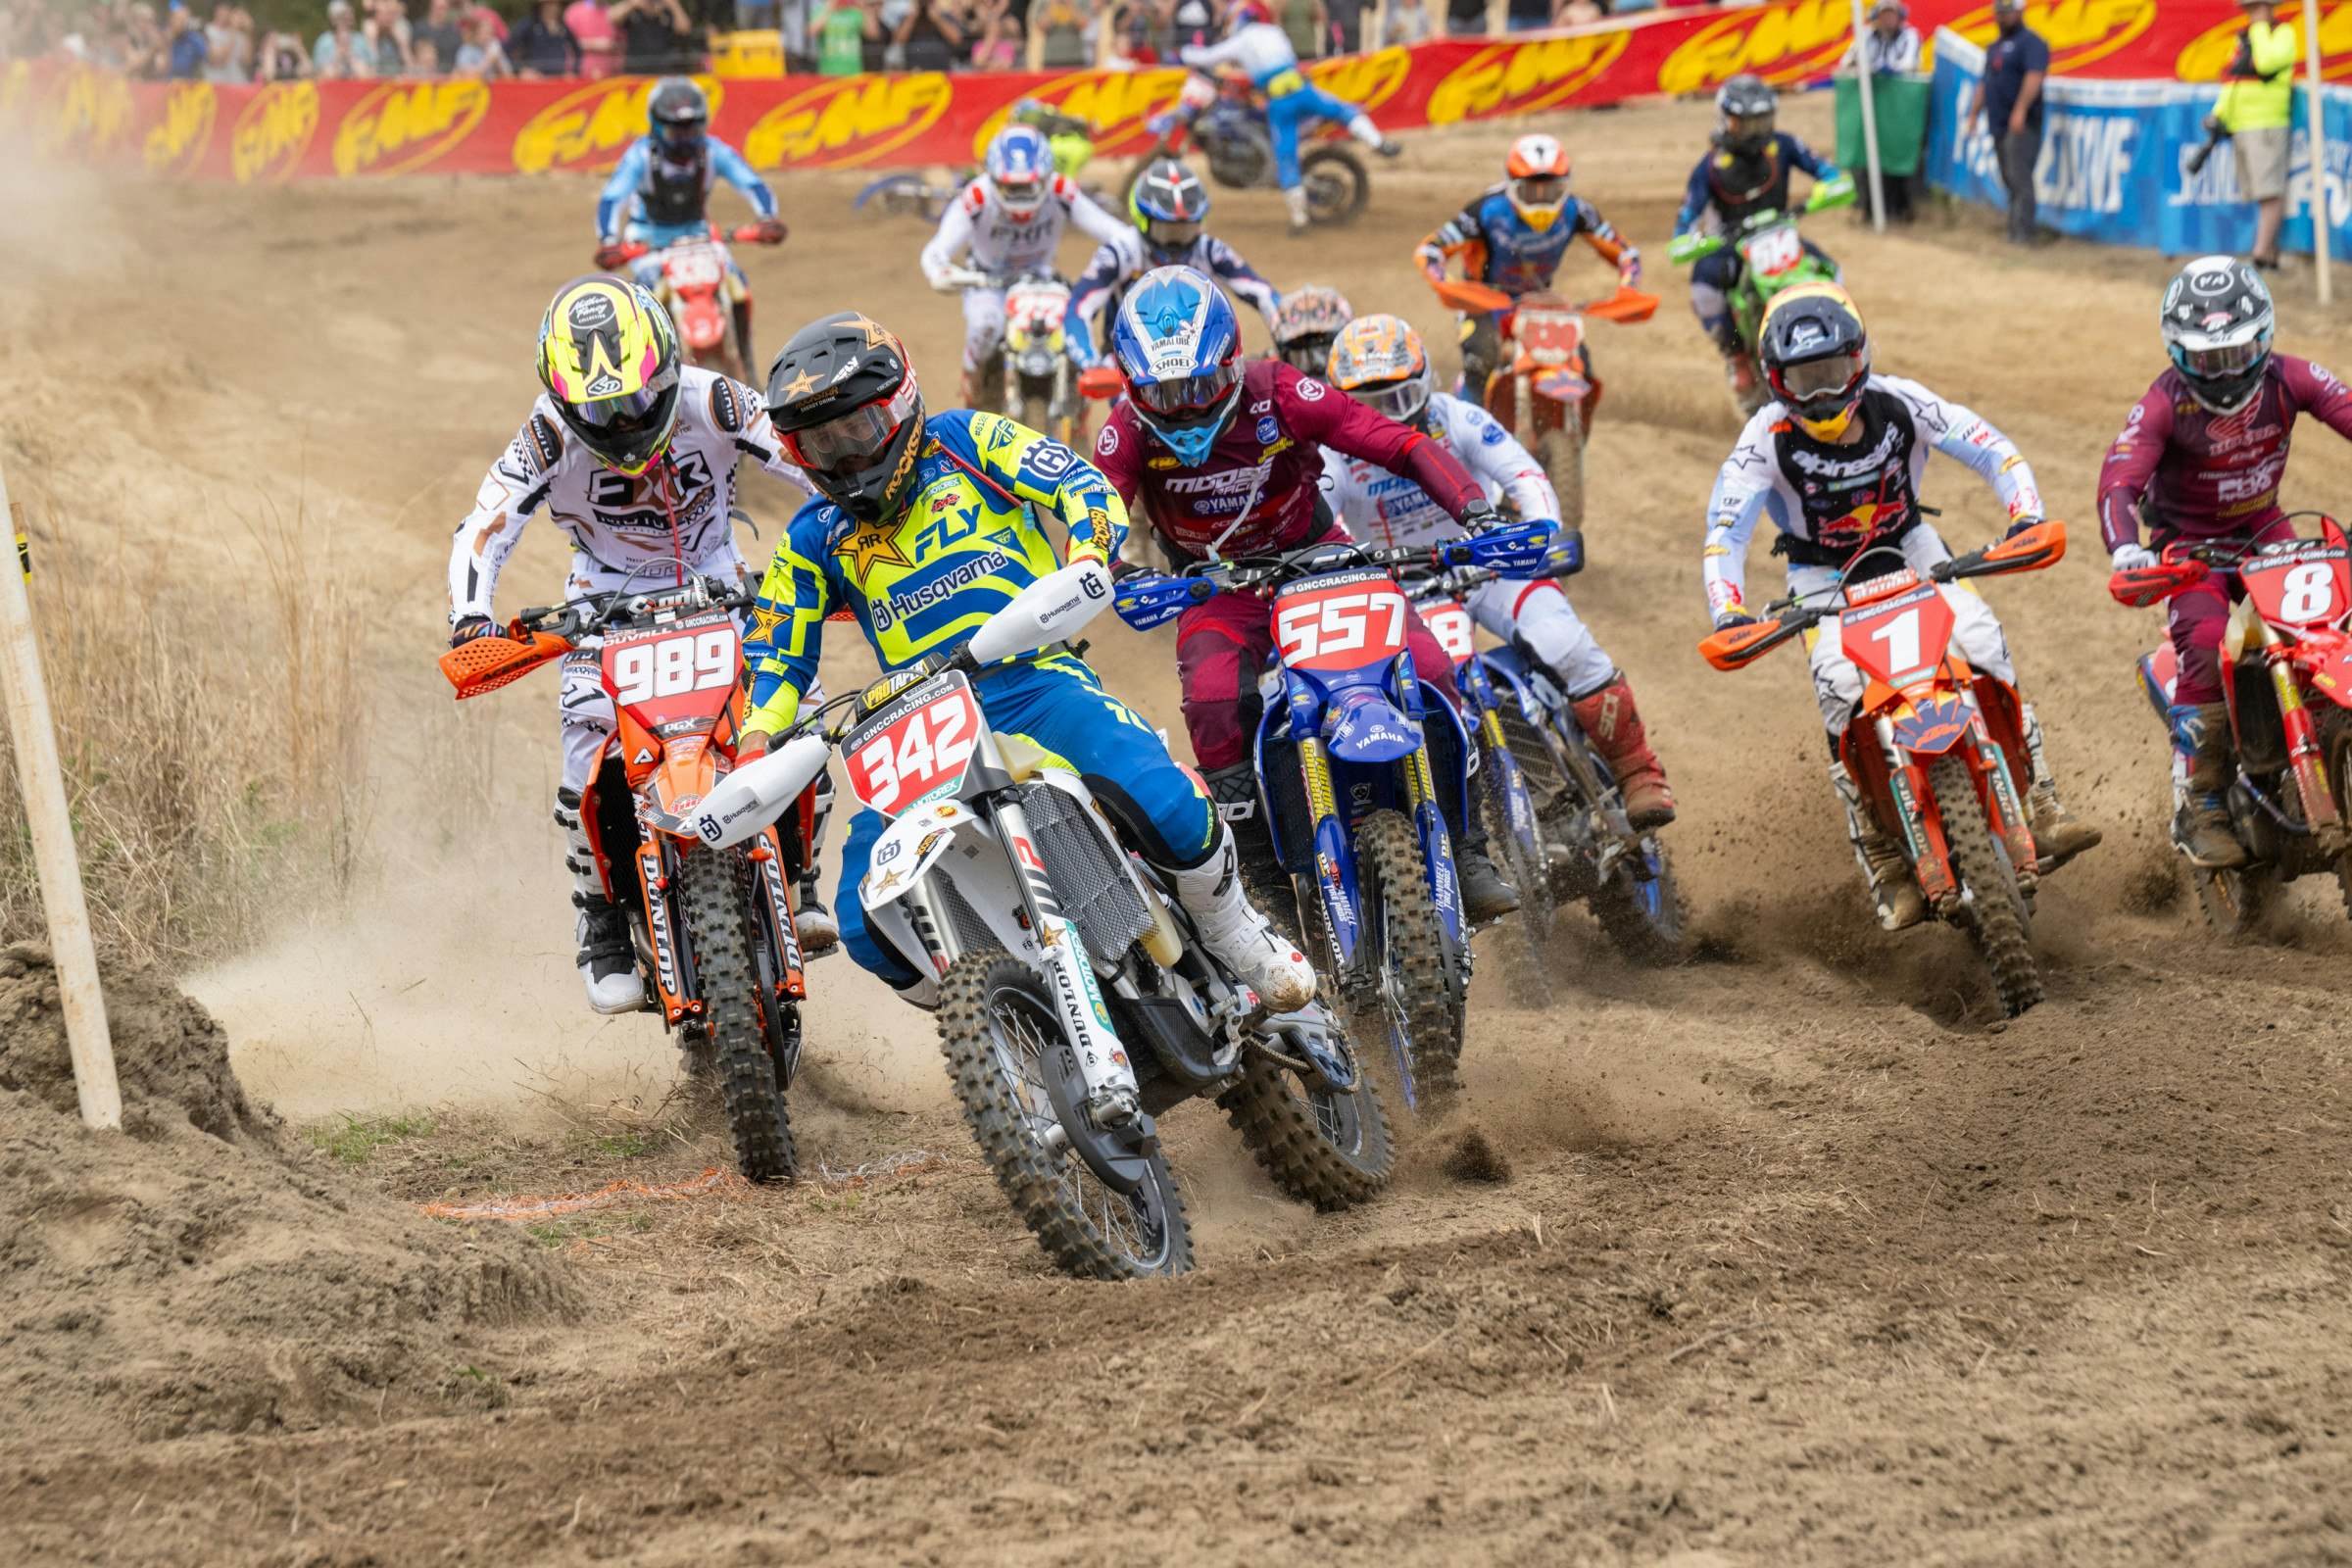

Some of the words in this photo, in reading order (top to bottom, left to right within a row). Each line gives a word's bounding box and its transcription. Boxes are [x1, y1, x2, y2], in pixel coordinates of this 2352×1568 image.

[1428, 30, 1617, 124] FMF
[332, 78, 491, 180] FMF
[744, 72, 948, 169] FMF
[1151, 335, 1192, 352] YAMALUBE
[1154, 357, 1191, 372] SHOEI
[1790, 421, 1900, 477] alpinestars
[927, 477, 960, 498] MOTOREX
[1164, 457, 1274, 493] MOOSE
[931, 494, 960, 514] IMS
[1209, 491, 1264, 513] YAMAA
[914, 502, 983, 564] FLY
[888, 550, 1009, 621] Husqvarna
[1296, 571, 1389, 593] GNCCRACING.COM
[1512, 558, 1538, 567] YAMAHA
[1047, 595, 1080, 619] Husqvarna
[2280, 562, 2334, 623] 8
[603, 627, 673, 648] DUVALL
[1134, 613, 1158, 626] YAMAHA
[1278, 592, 1406, 668] 557
[1423, 610, 1473, 658] 8
[1871, 607, 1921, 676] 1
[614, 628, 736, 707] 989
[866, 660, 927, 705] PROTAPER
[862, 684, 956, 742] GNCCRACING.COM
[1914, 722, 1961, 749] KTM
[861, 694, 972, 812] 342
[1356, 732, 1405, 750] YAMAHA
[911, 779, 957, 809] MOTOREX
[1984, 746, 2013, 816] DUNLP
[729, 799, 759, 820] Husqvarna
[1337, 882, 1357, 926] AMMELL
[1435, 860, 1446, 913] TRAMMELL
[1444, 868, 1454, 894] PROS
[1444, 889, 1455, 911] TIRE
[642, 855, 677, 995] DUNLOP
[1322, 898, 1346, 965] DUNLOP
[1068, 928, 1102, 1003] MOTOREX
[1054, 959, 1094, 1049] DUNLOP
